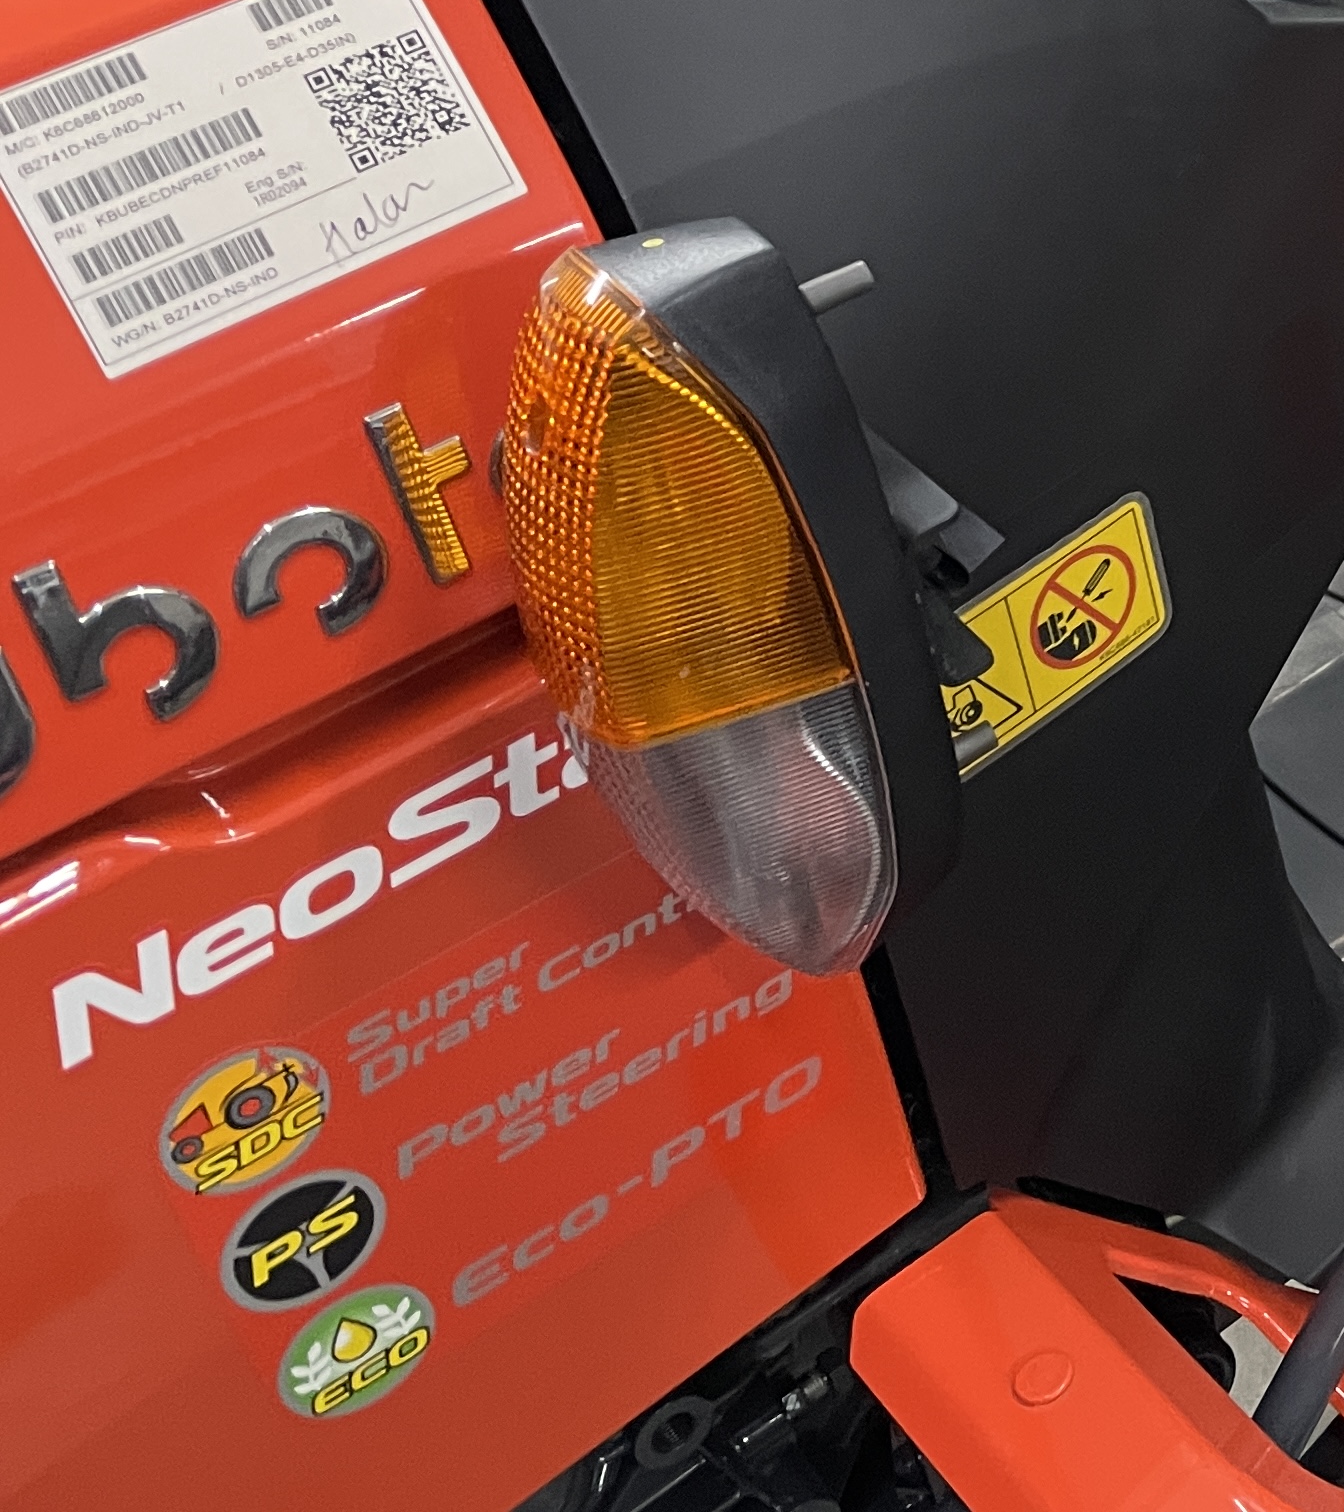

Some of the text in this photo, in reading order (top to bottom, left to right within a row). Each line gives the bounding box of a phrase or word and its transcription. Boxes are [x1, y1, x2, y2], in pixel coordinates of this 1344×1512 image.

[300, 13, 342, 37] 11084
[243, 173, 275, 197] Eng
[346, 939, 531, 1065] Super
[358, 890, 696, 1097] Draft Cont
[397, 1027, 622, 1181] Power
[496, 967, 794, 1164] Steering
[194, 1091, 326, 1196] SDC
[452, 1055, 824, 1309] Eco-PTO
[249, 1192, 361, 1290] PS
[311, 1324, 432, 1418] ECO
